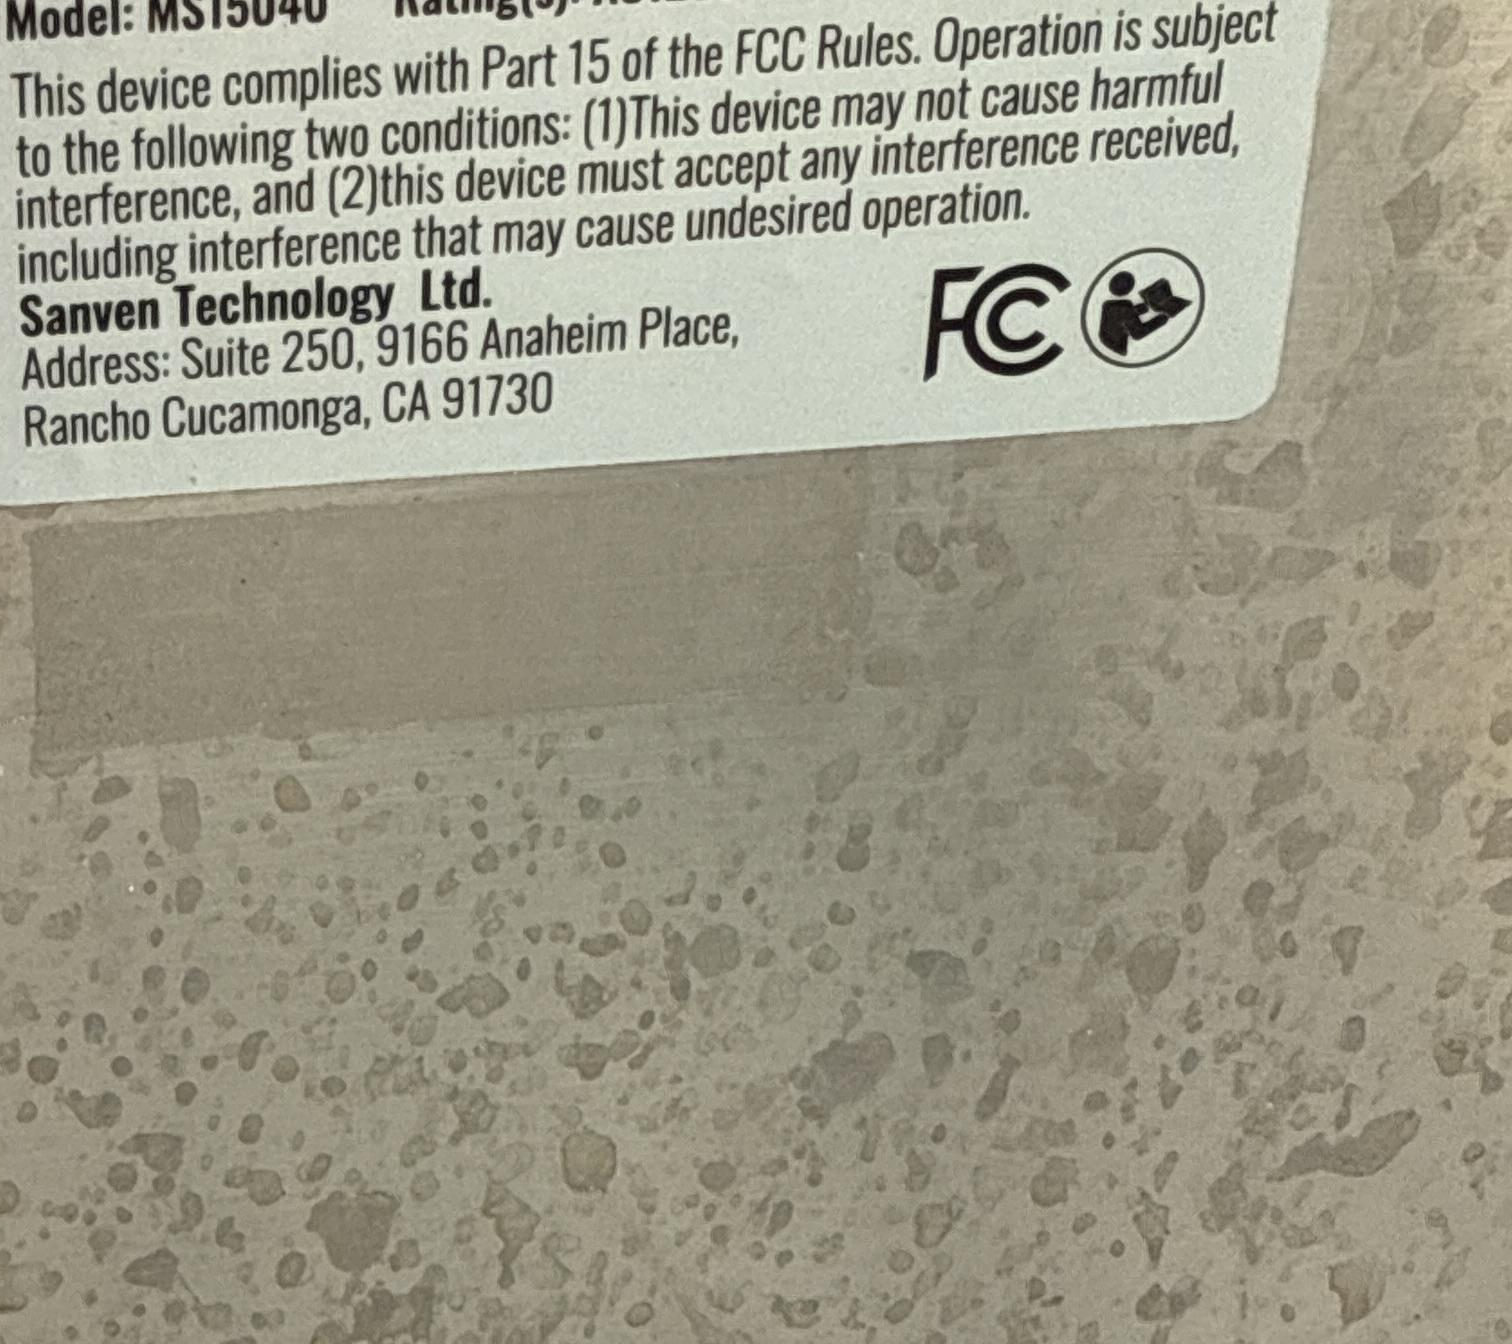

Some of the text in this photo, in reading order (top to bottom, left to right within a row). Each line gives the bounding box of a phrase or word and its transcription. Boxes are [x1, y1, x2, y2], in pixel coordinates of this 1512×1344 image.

[10, 1, 1278, 118] This device complies with Part 15 of the FCC Rules. Operation is subject
[16, 136, 50, 178] to
[63, 130, 120, 175] the
[131, 122, 295, 172] following
[305, 118, 368, 160] two
[382, 106, 570, 164] conditions:
[711, 90, 821, 134] device
[832, 91, 906, 131] may
[915, 78, 971, 122] not
[981, 80, 1079, 118] cause
[1091, 59, 1224, 111] harmful
[16, 182, 240, 230] interference,
[253, 168, 314, 215] and
[456, 157, 565, 202] device
[578, 149, 664, 194] must
[675, 141, 791, 193] accept
[801, 145, 862, 185] any
[871, 128, 1079, 175] interference
[1090, 110, 1238, 162] received,
[18, 183, 1029, 284] including interference that may cause undesired operation.
[20, 265, 492, 337] Sanven Technology Ltd.
[22, 306, 738, 390] Address: Suite 250, 9166 Anaheim Place,
[25, 371, 552, 447] Rancho Cucamonga, CA 91730
